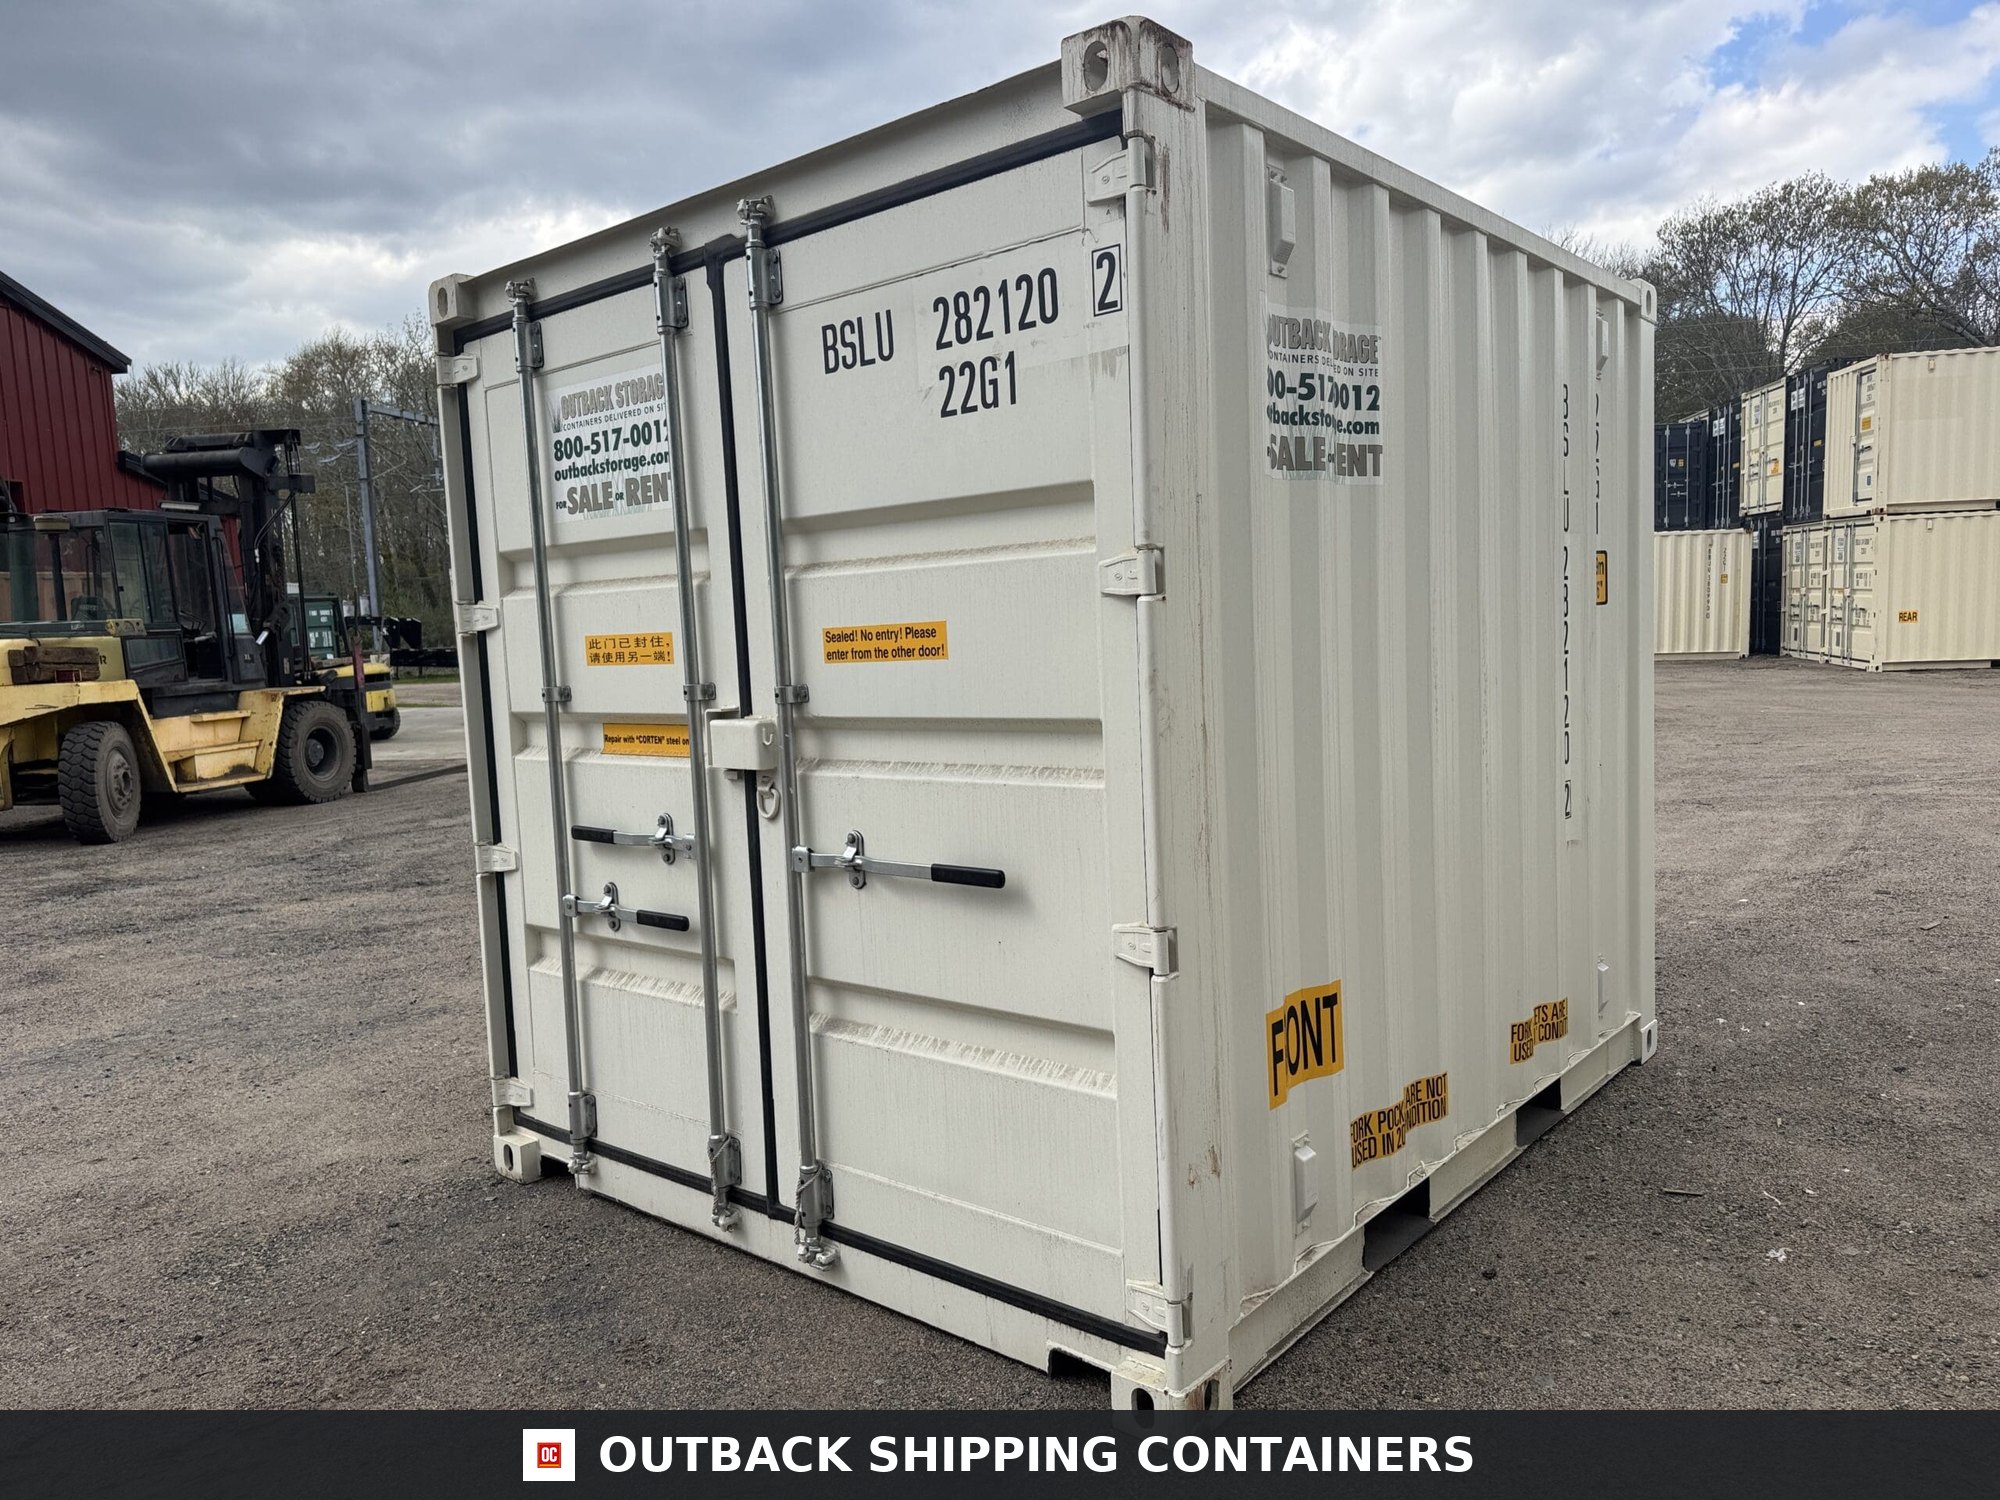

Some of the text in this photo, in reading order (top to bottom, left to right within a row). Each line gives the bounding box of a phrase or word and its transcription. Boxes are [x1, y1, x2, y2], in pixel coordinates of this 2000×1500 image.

[821, 251, 1119, 374] BSLU 282120 2
[939, 351, 1017, 418] 22G1
[1343, 367, 1354, 376] ON
[1358, 368, 1379, 377] SITE
[560, 373, 666, 420] OUTBACK STORAG
[563, 414, 602, 431] CONTAINERS
[604, 408, 642, 423] DELIVERED
[644, 405, 655, 415] ON
[1336, 442, 1383, 477] ENT
[556, 472, 672, 515] FOR SALE OR REN
[1898, 611, 1918, 622] REAR
[825, 626, 936, 643] Sealed! No entry! Please
[826, 643, 945, 660] enter from the other door!
[604, 734, 621, 745] Repair
[623, 735, 635, 743] with
[666, 736, 680, 745] steel
[1426, 1073, 1447, 1099] NOT
[1352, 1137, 1377, 1168] USED
[1382, 1131, 1394, 1155] IN
